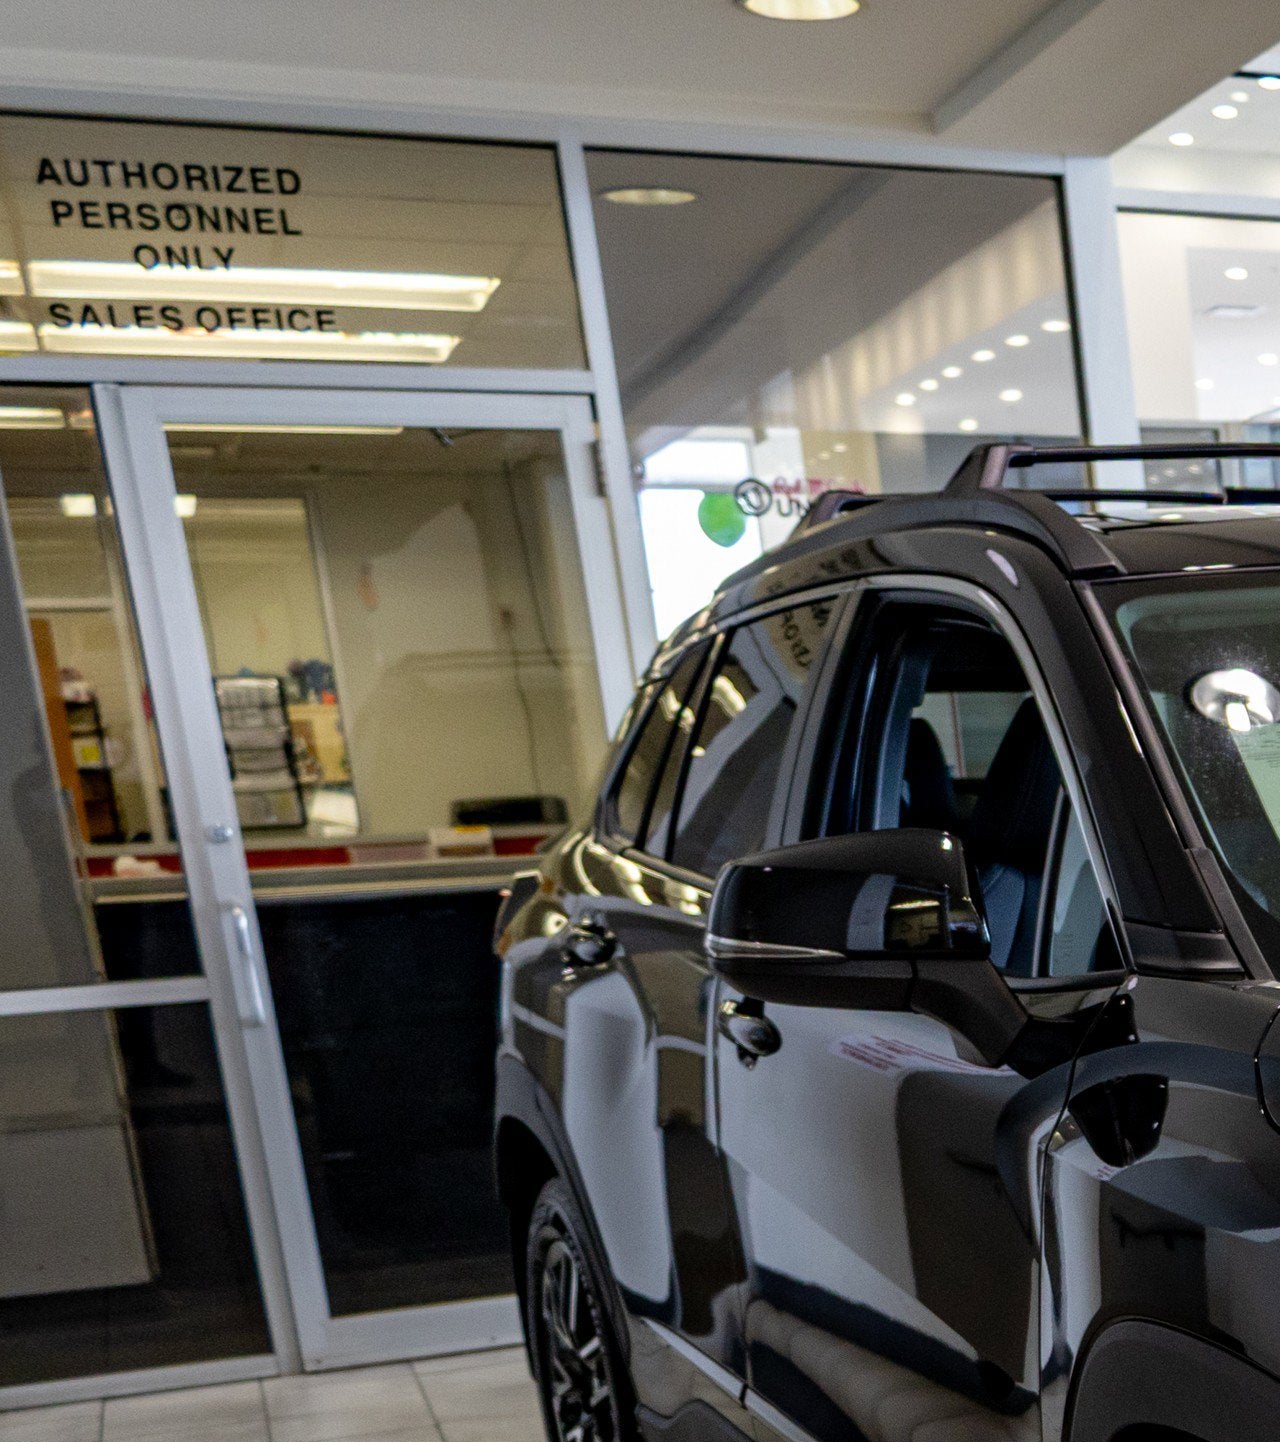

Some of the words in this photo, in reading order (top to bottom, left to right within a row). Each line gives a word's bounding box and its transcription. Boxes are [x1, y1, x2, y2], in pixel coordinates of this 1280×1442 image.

[36, 158, 300, 195] AUTHORIZED
[50, 200, 303, 236] PERSONNEL
[133, 243, 235, 271] ONLY
[49, 303, 184, 332] SALES
[196, 306, 337, 334] OFFICE
